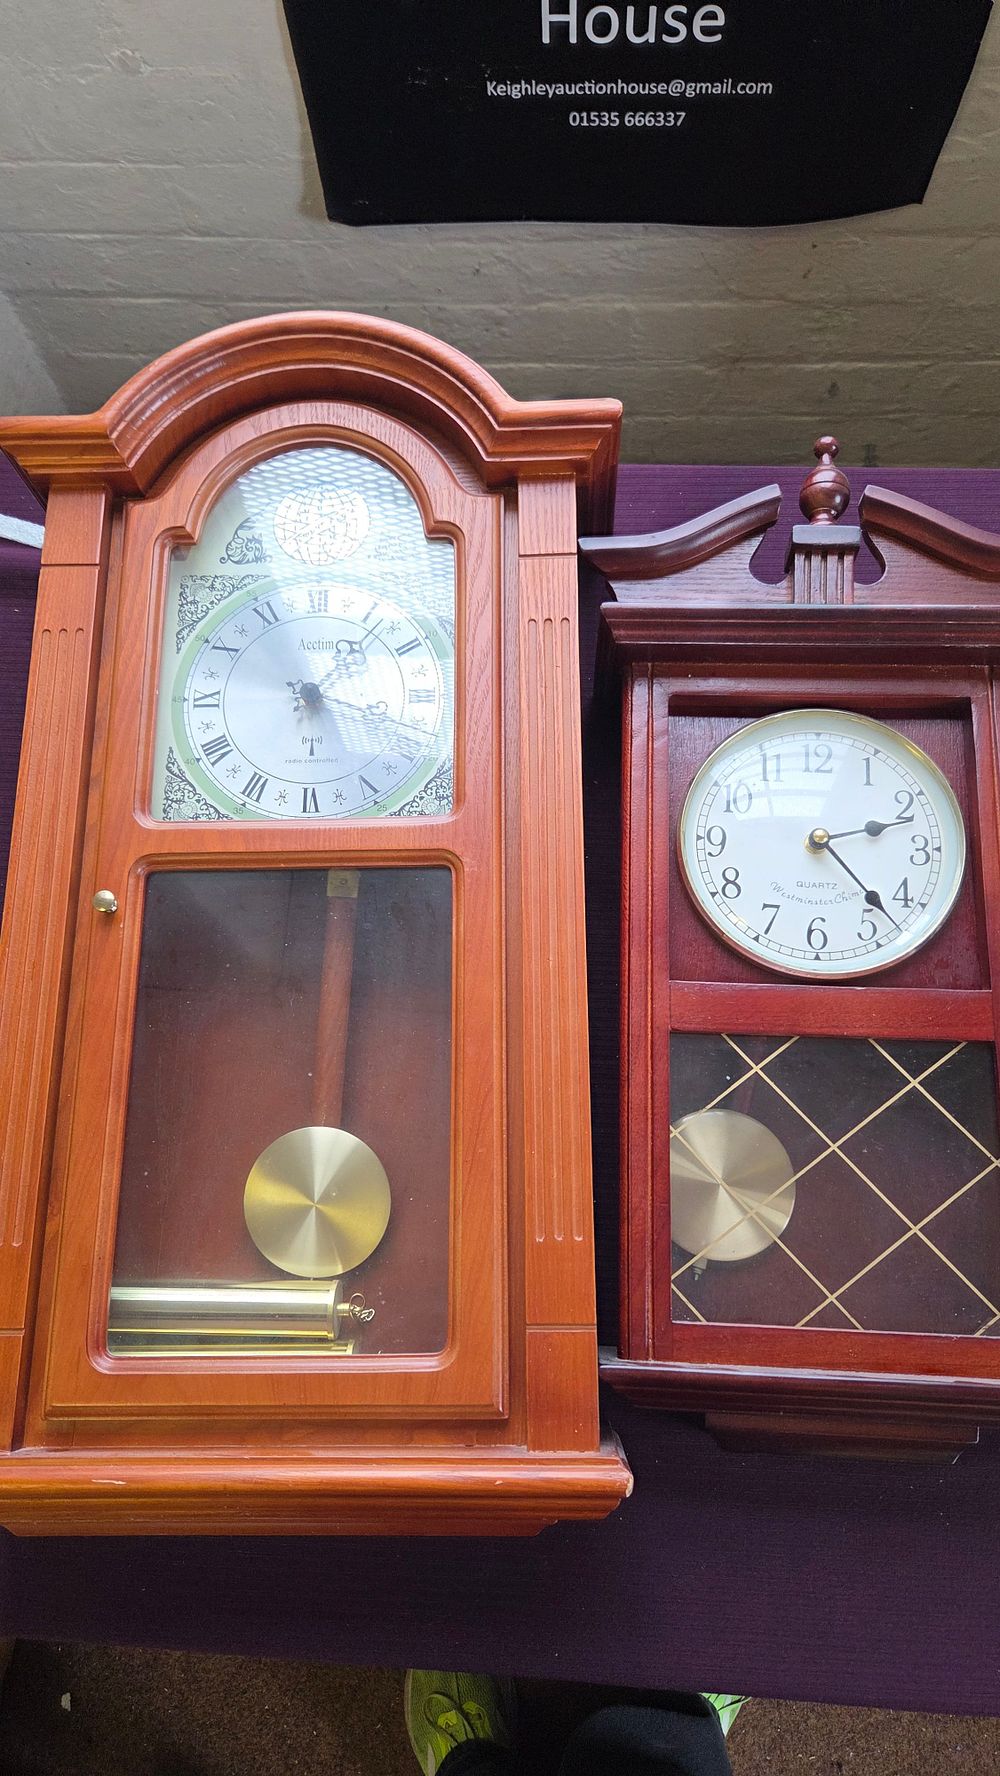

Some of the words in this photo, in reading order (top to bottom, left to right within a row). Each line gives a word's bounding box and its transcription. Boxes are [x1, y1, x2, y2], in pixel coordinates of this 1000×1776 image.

[540, 0, 726, 44] House
[486, 79, 773, 99] Keighleyauctionhouse@gmail.com
[569, 112, 620, 127] 01535
[624, 112, 686, 127] 666337
[252, 600, 281, 630] XI
[307, 589, 330, 614] XII
[195, 634, 205, 642] 50
[210, 636, 241, 661] X
[298, 637, 334, 651] Acctim
[394, 636, 423, 656] II
[193, 688, 221, 710] IX
[408, 687, 435, 704] III
[200, 732, 234, 768] VIII
[803, 743, 833, 774] 12
[760, 752, 784, 783] 11
[862, 757, 874, 787] 1
[239, 771, 269, 804] VII
[301, 787, 320, 813] VI
[358, 774, 381, 800] V
[723, 782, 753, 814] 10
[232, 806, 244, 815] 35
[376, 804, 388, 812] 25
[894, 789, 915, 821] 2
[706, 825, 727, 857] 9
[909, 834, 931, 866] 3
[721, 866, 742, 899] 8
[796, 880, 838, 890] QUARTZ
[892, 876, 914, 908] 4
[761, 902, 781, 936] 7
[806, 916, 829, 951] 6
[857, 908, 878, 942] 5
